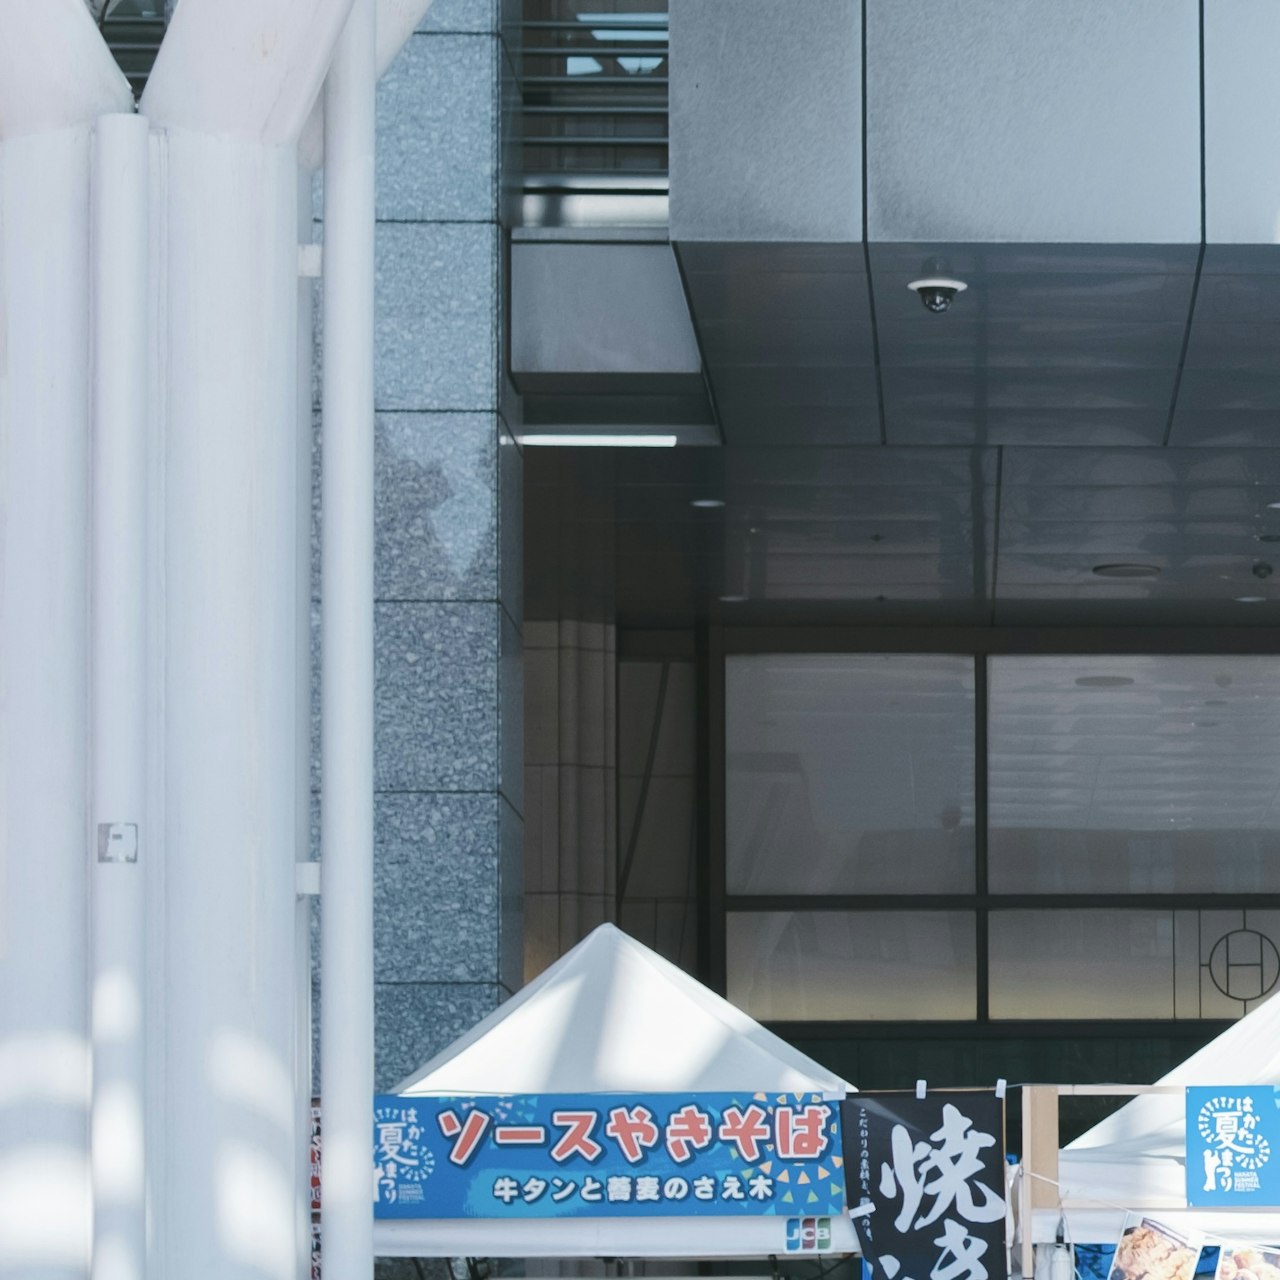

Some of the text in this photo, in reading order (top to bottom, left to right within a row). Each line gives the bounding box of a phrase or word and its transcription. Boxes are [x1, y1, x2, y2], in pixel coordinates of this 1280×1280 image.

[438, 1105, 831, 1163] ソースやきそば
[492, 1175, 775, 1202] 牛タンと蕎麦のさえ木
